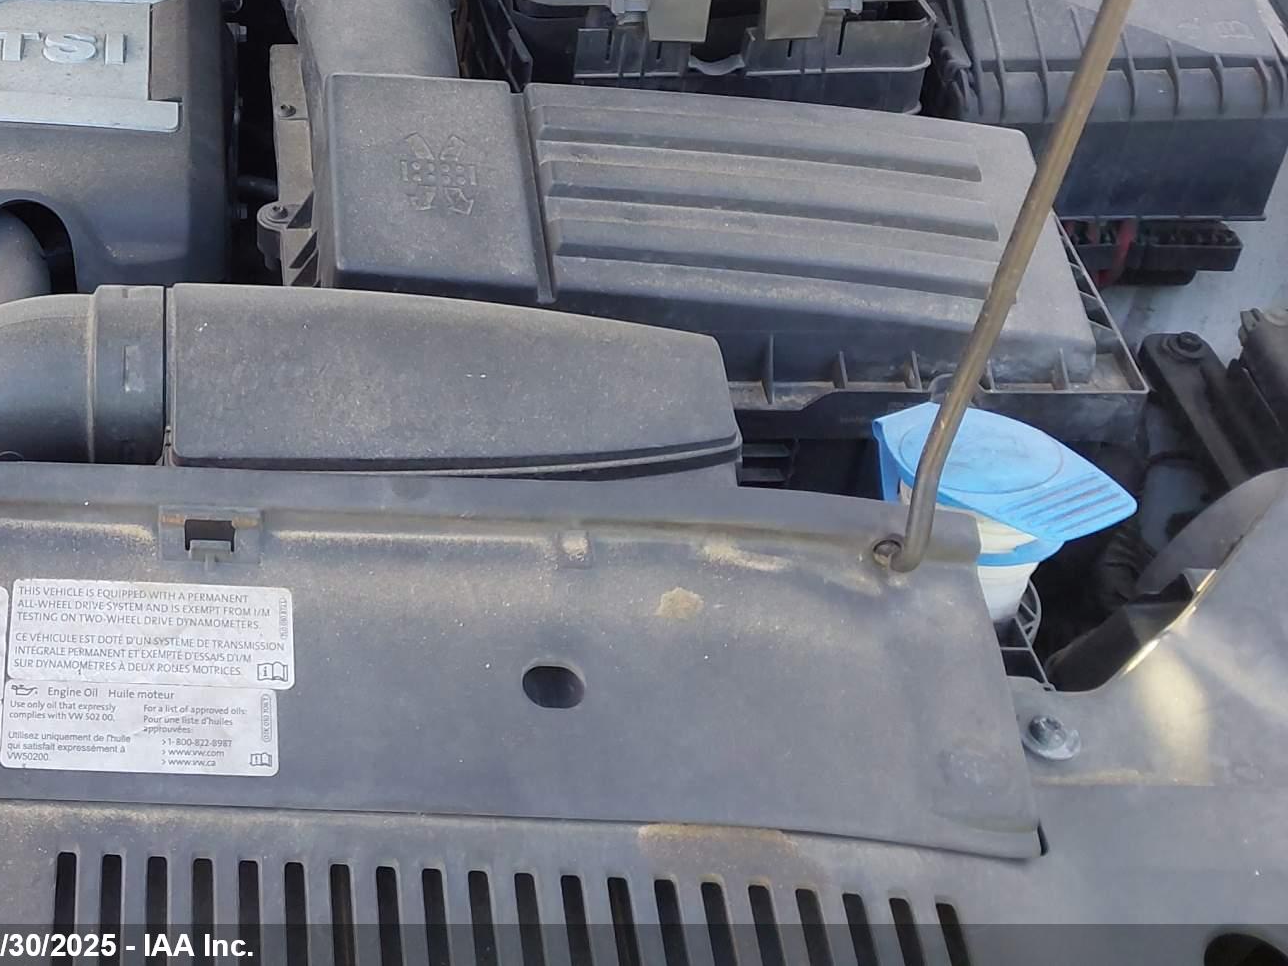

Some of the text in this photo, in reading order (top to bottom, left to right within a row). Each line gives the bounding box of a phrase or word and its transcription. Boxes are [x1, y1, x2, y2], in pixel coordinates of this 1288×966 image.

[19, 586, 248, 603] THIS VEHICLE IS EQUIPPED WITH A PERMANENT
[18, 600, 270, 617] ALL-WHEEL DRIVE SYSTEM AND IS EXEMPT FROM I/M
[17, 612, 58, 622] TESTING
[60, 613, 76, 622] ON
[80, 614, 141, 624] TWO-WHEEL
[144, 616, 173, 626] DRIVE
[16, 633, 27, 642] CE
[79, 635, 95, 644] EST
[126, 636, 151, 646] D'UN
[196, 639, 209, 648] DE
[213, 640, 284, 651] TRANSMISSION
[68, 648, 125, 658] PERMANENT
[128, 649, 140, 658] ET
[14, 659, 34, 668] SUR
[127, 662, 155, 672] DEUX
[157, 663, 190, 673] ROUES
[193, 665, 241, 676] MOTRICES
[47, 686, 175, 700] Engine Oil Huile moteur
[10, 700, 116, 712] Use only oil that expressly
[144, 704, 156, 713] For
[165, 705, 178, 713] list
[190, 707, 229, 716] approved
[9, 710, 45, 720] complies
[47, 712, 66, 720] with
[86, 713, 100, 721] 502
[144, 715, 162, 724] Pour
[164, 716, 180, 724] une
[182, 717, 200, 725] liste
[41, 733, 91, 743] uniquement
[93, 734, 104, 742] de
